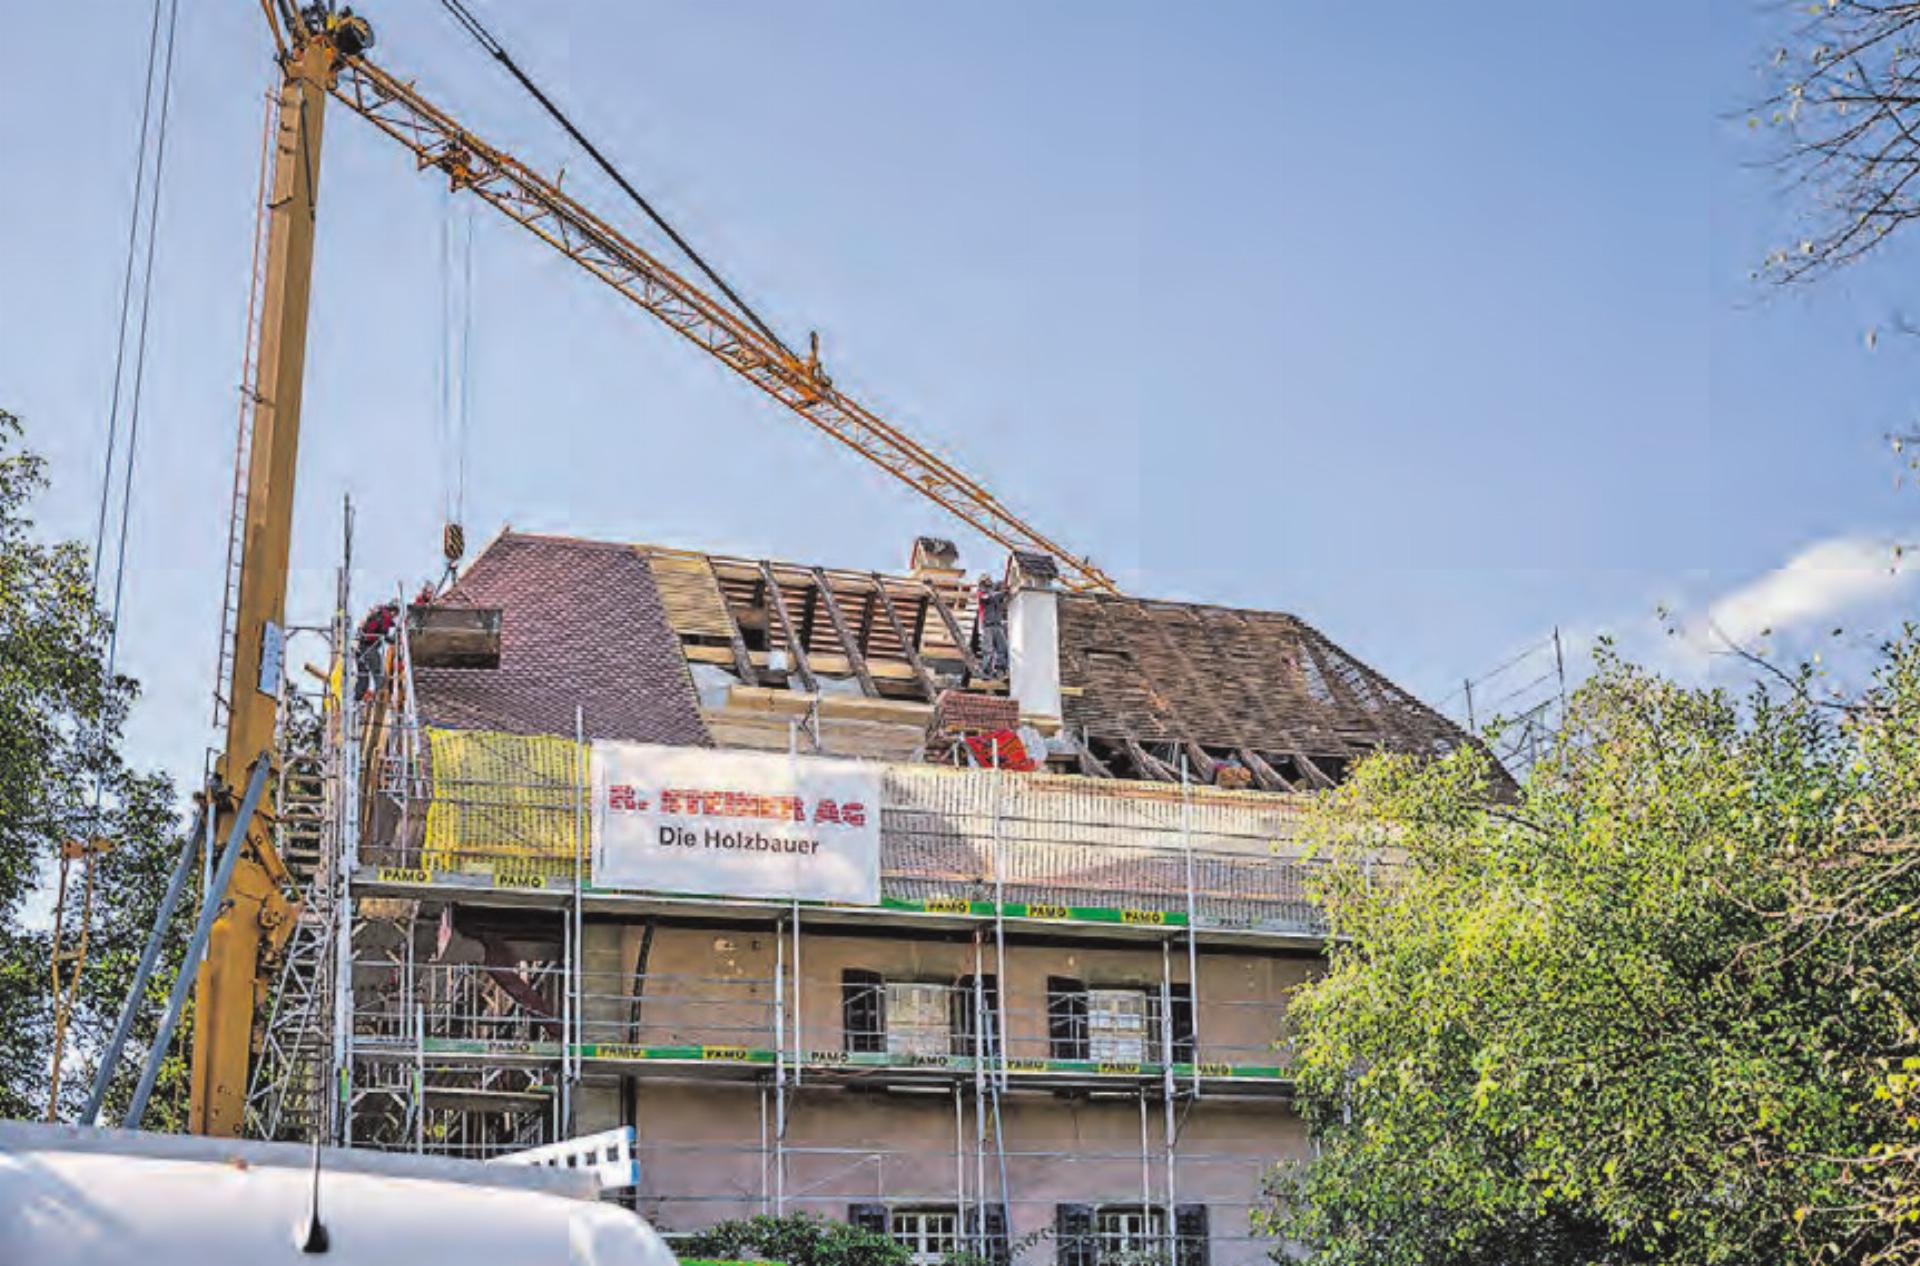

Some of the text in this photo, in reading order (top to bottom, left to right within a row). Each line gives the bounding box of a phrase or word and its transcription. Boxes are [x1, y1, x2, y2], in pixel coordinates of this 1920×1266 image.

[814, 799, 866, 827] AG
[659, 826, 819, 856] Die Holzbauer
[383, 869, 428, 882] PAMO
[499, 874, 542, 889] PAMO
[928, 902, 968, 914] PAMO
[1029, 905, 1067, 919] PAMO
[1124, 911, 1161, 925] PAMO
[811, 1051, 849, 1063] PAMO
[911, 1056, 947, 1066] PAMO
